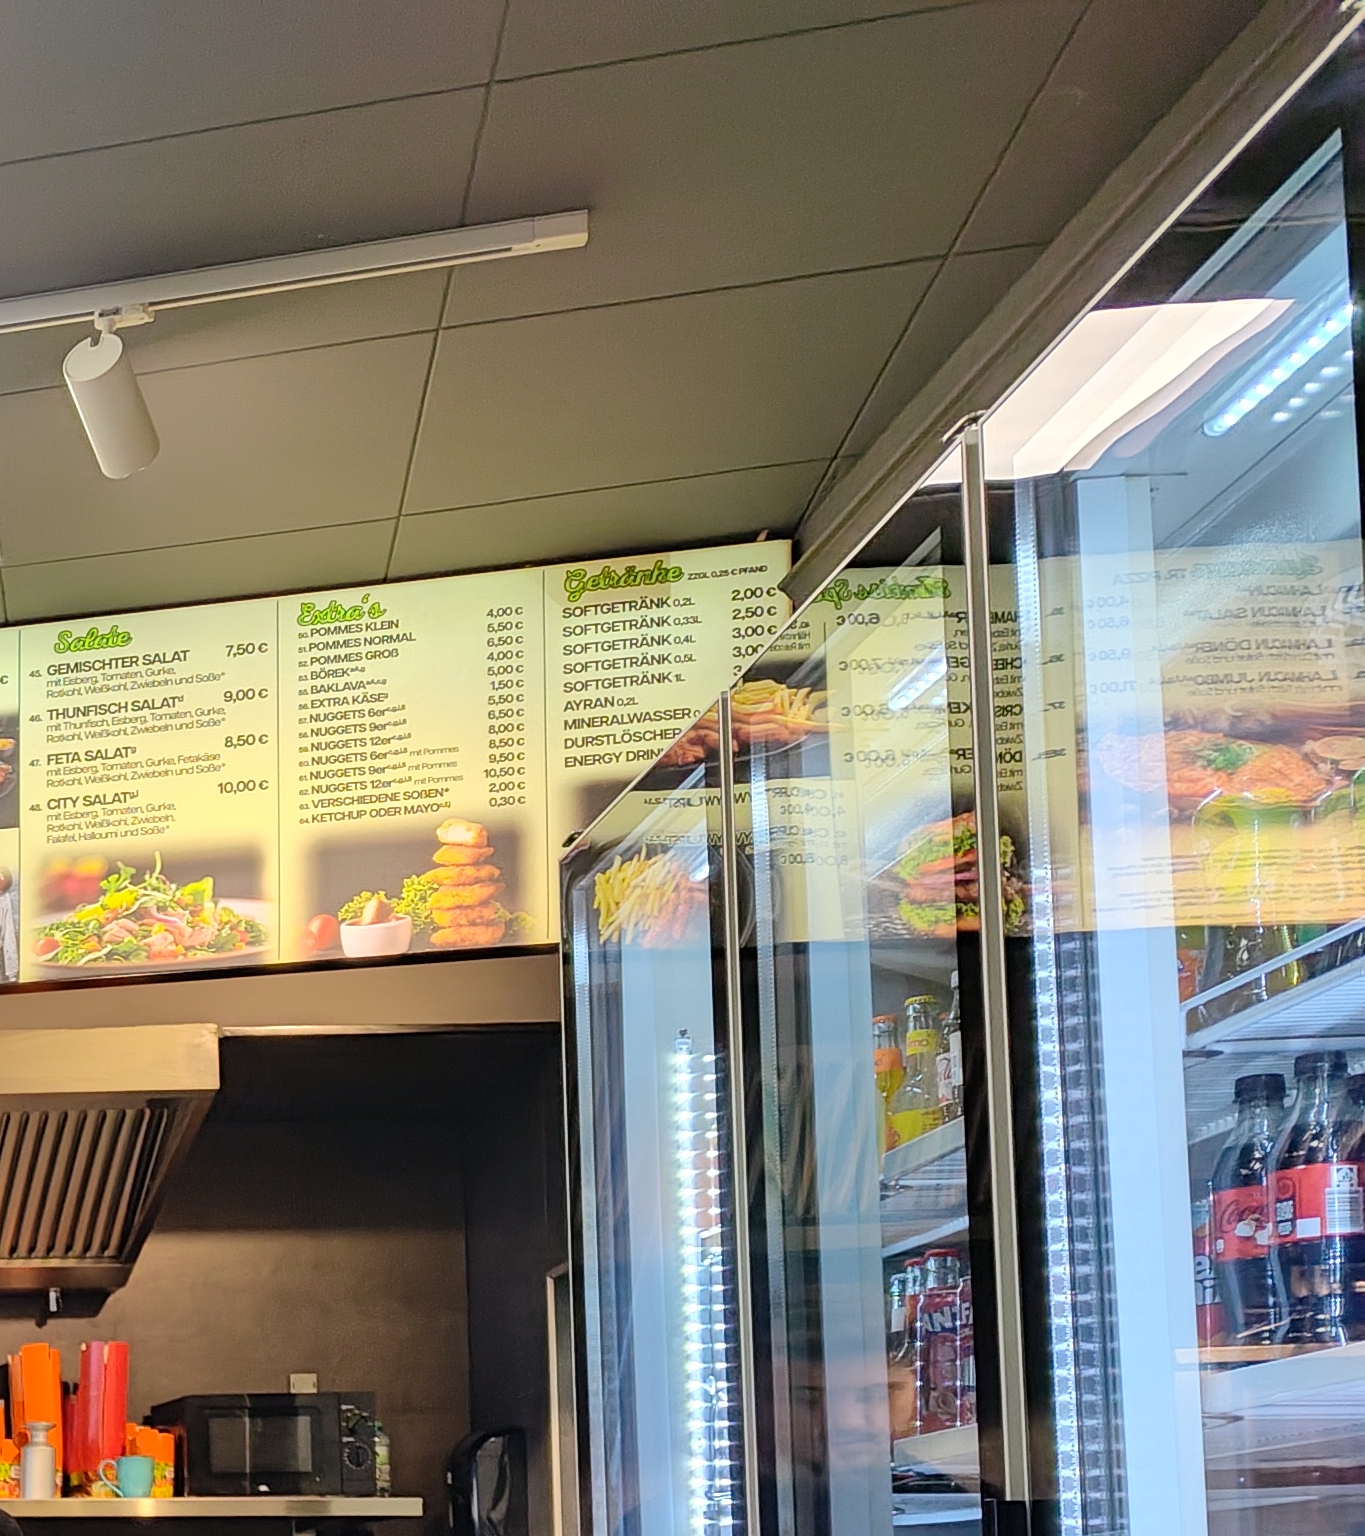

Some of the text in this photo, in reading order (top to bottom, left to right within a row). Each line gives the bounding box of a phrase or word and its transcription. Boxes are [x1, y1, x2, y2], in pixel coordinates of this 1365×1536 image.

[564, 560, 685, 602] Getränke
[562, 596, 695, 619] SOFTGETRÄNK 0,2L
[311, 619, 399, 637] POMMES KLEIN
[563, 615, 703, 637] SOFTGETRÄNK 0,33L
[54, 625, 133, 654] Salate
[309, 632, 417, 652] POMMES NORMAL
[47, 650, 190, 676] GEMISCHTER SALAT
[310, 652, 363, 666] POMMES
[563, 671, 685, 693] SOFTGETRÄNK 1L
[47, 701, 128, 720] THUNFISCH
[311, 697, 350, 709] EXTRA
[563, 696, 639, 712] AYRAN 0,2L
[564, 708, 691, 731] MINERALWASSER
[47, 752, 81, 765] FETA
[565, 748, 663, 768] ENERGY DRIN
[47, 796, 80, 810] CITY
[311, 792, 401, 809] VERSCHIEDENE
[312, 807, 401, 823] KETCHUP ODER
